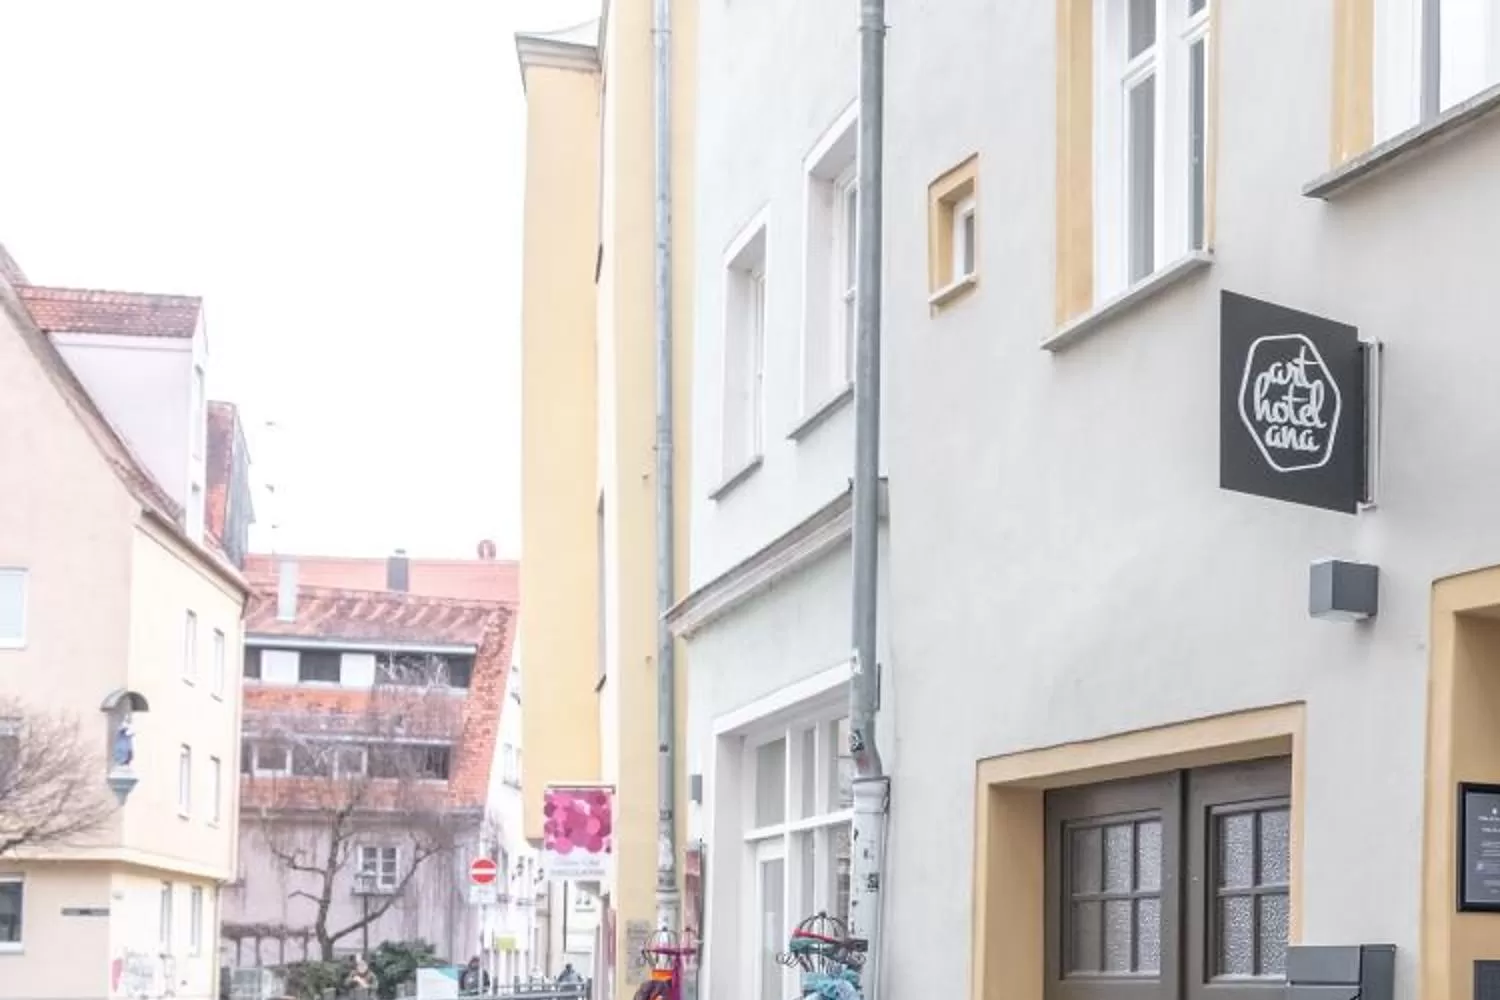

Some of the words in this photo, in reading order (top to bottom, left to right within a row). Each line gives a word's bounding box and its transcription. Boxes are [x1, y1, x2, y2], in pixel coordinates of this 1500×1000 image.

[1269, 345, 1321, 387] art
[1254, 371, 1328, 428] hotel
[1265, 425, 1320, 452] ana
